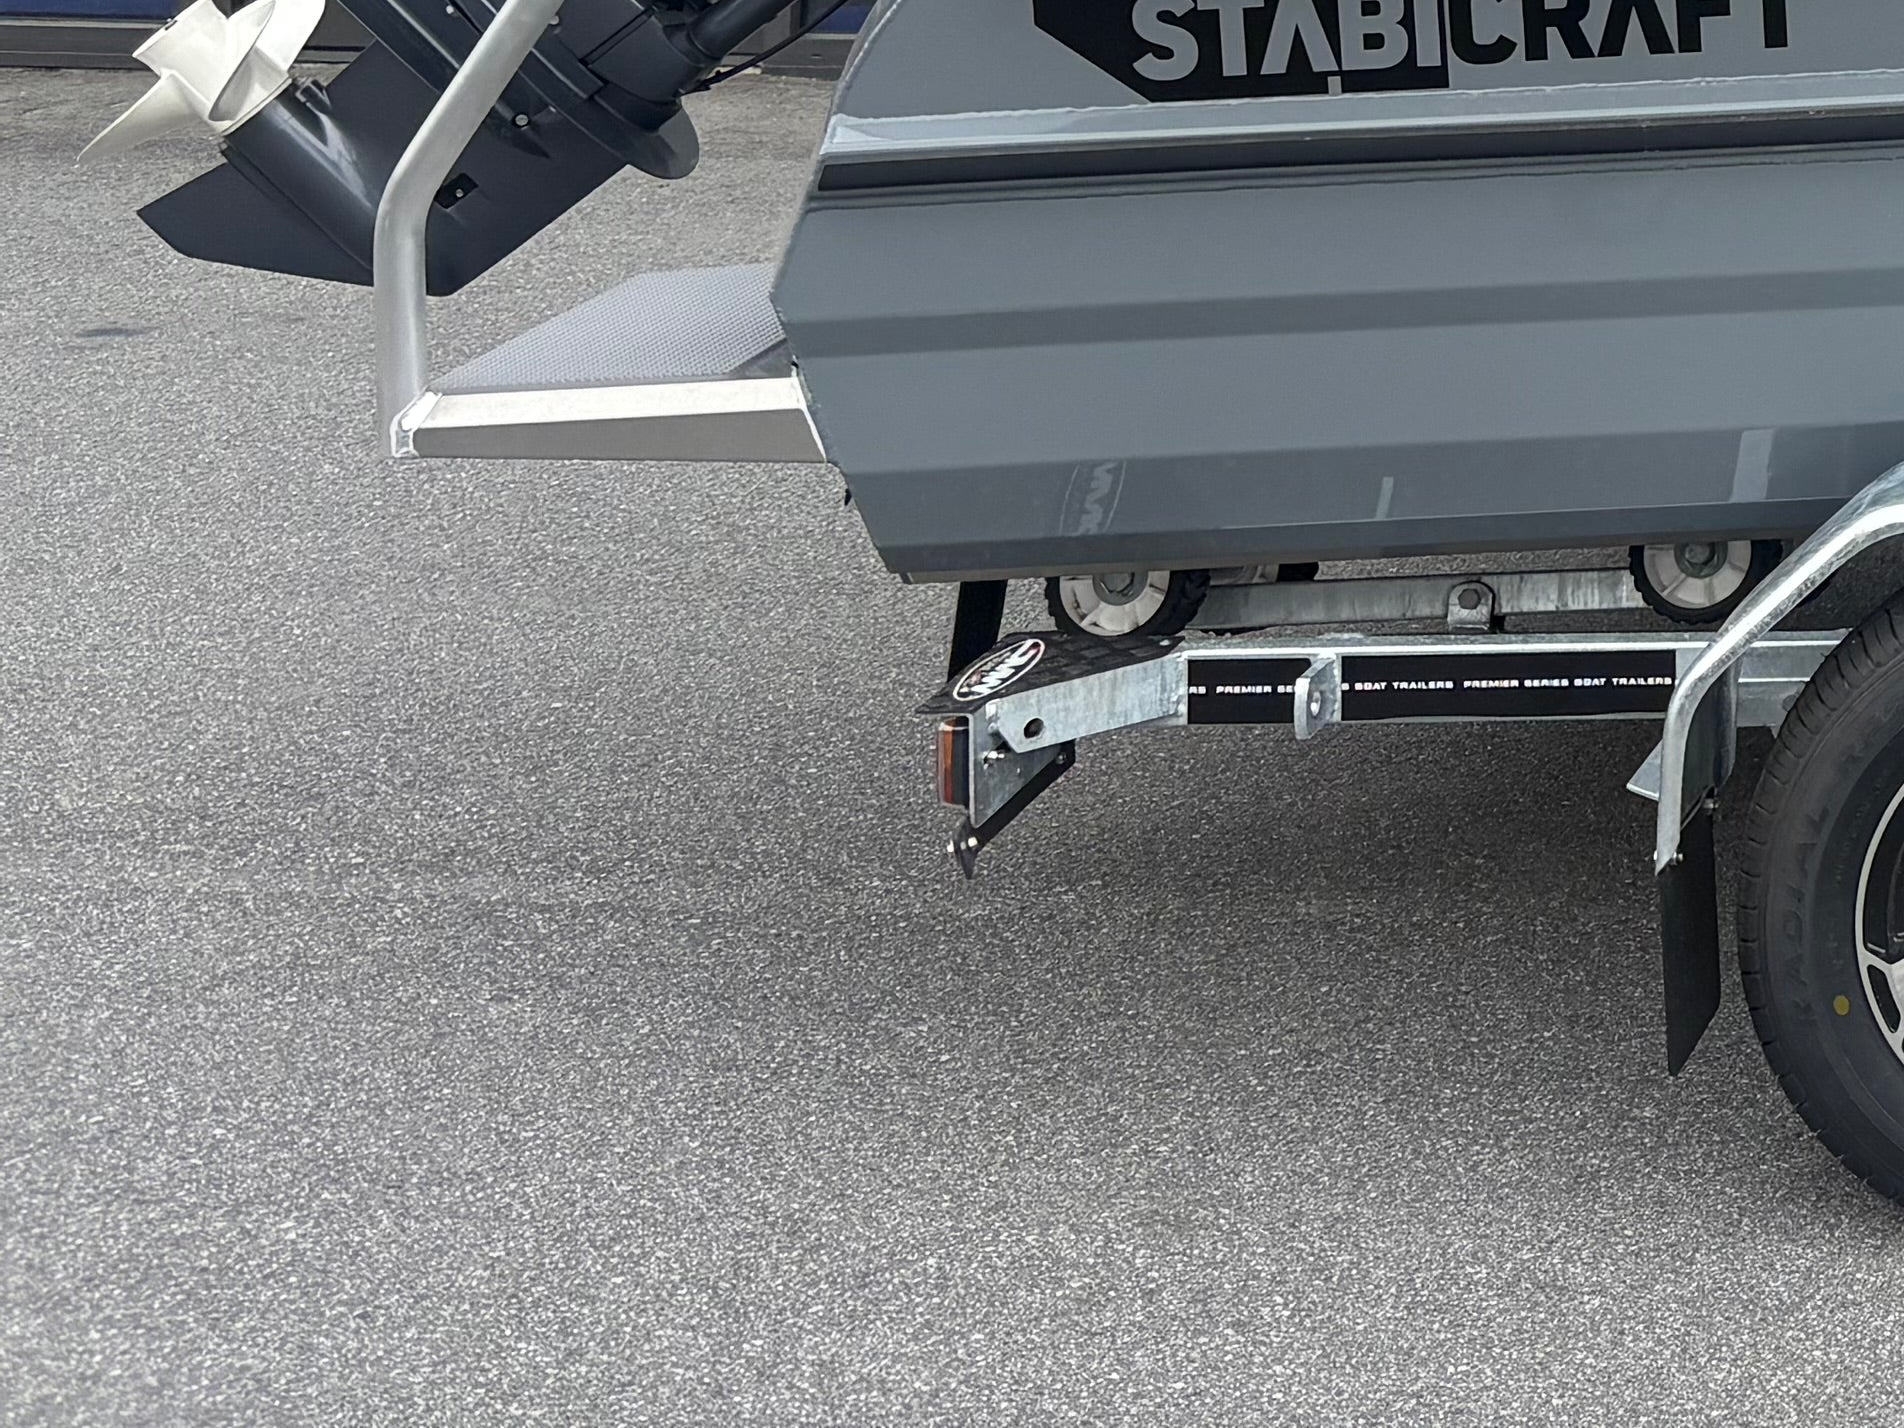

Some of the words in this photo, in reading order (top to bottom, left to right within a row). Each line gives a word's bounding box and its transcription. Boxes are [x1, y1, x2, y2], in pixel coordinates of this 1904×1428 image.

[1215, 685, 1272, 694] PREMIER
[1355, 681, 1387, 691] BOAT
[1391, 680, 1454, 690] TRAILERS
[1463, 679, 1520, 689] PREMIER
[1523, 679, 1570, 688] SERIES
[1573, 677, 1607, 687] BOAT
[1611, 676, 1673, 686] TRAILERS
